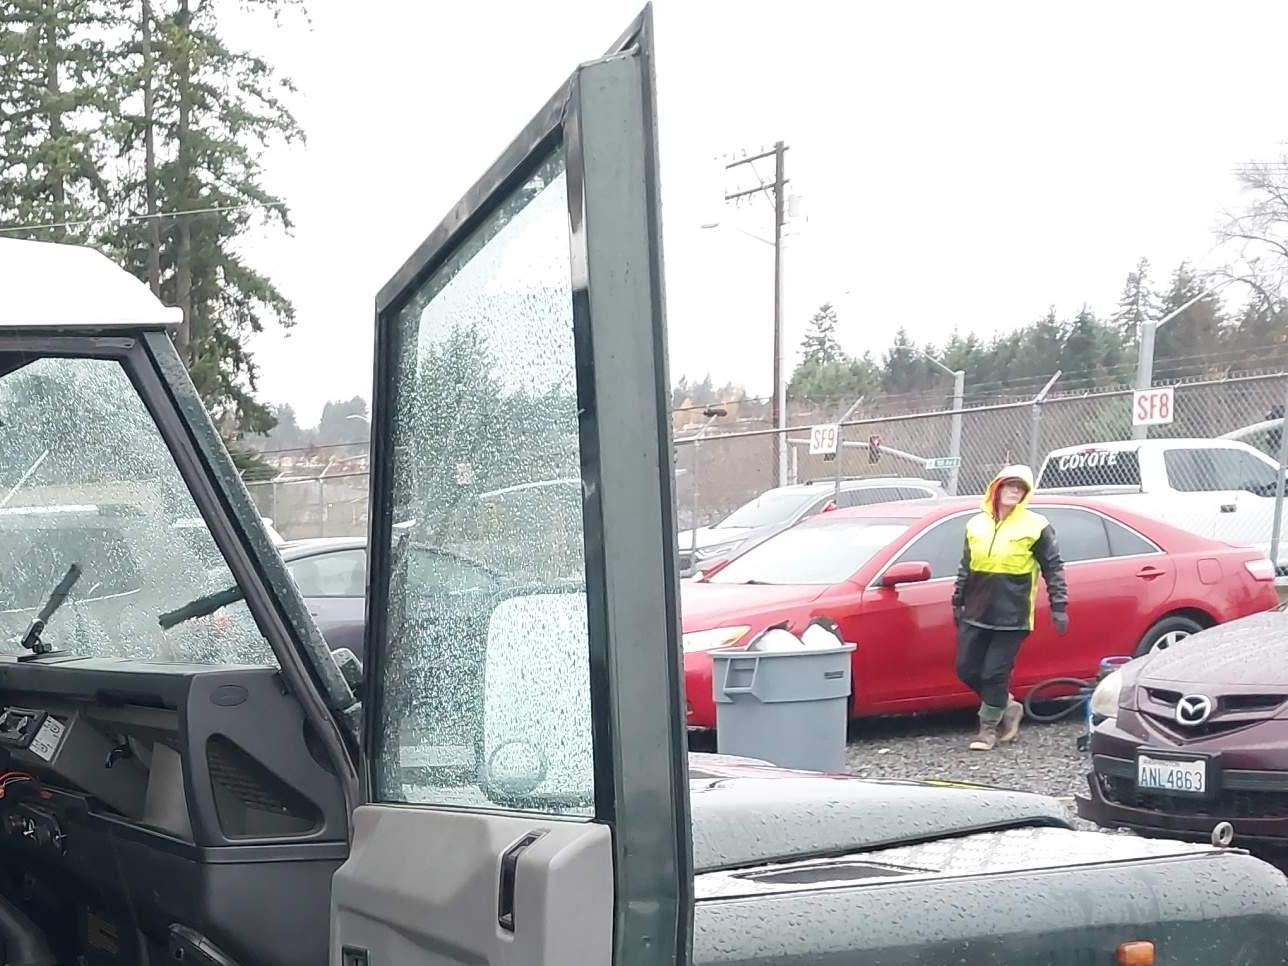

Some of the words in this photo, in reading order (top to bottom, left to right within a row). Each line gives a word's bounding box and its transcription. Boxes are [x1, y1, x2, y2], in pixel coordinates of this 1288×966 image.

[1138, 393, 1169, 420] SF8
[814, 428, 835, 449] SF9
[1059, 450, 1118, 470] COYOTE
